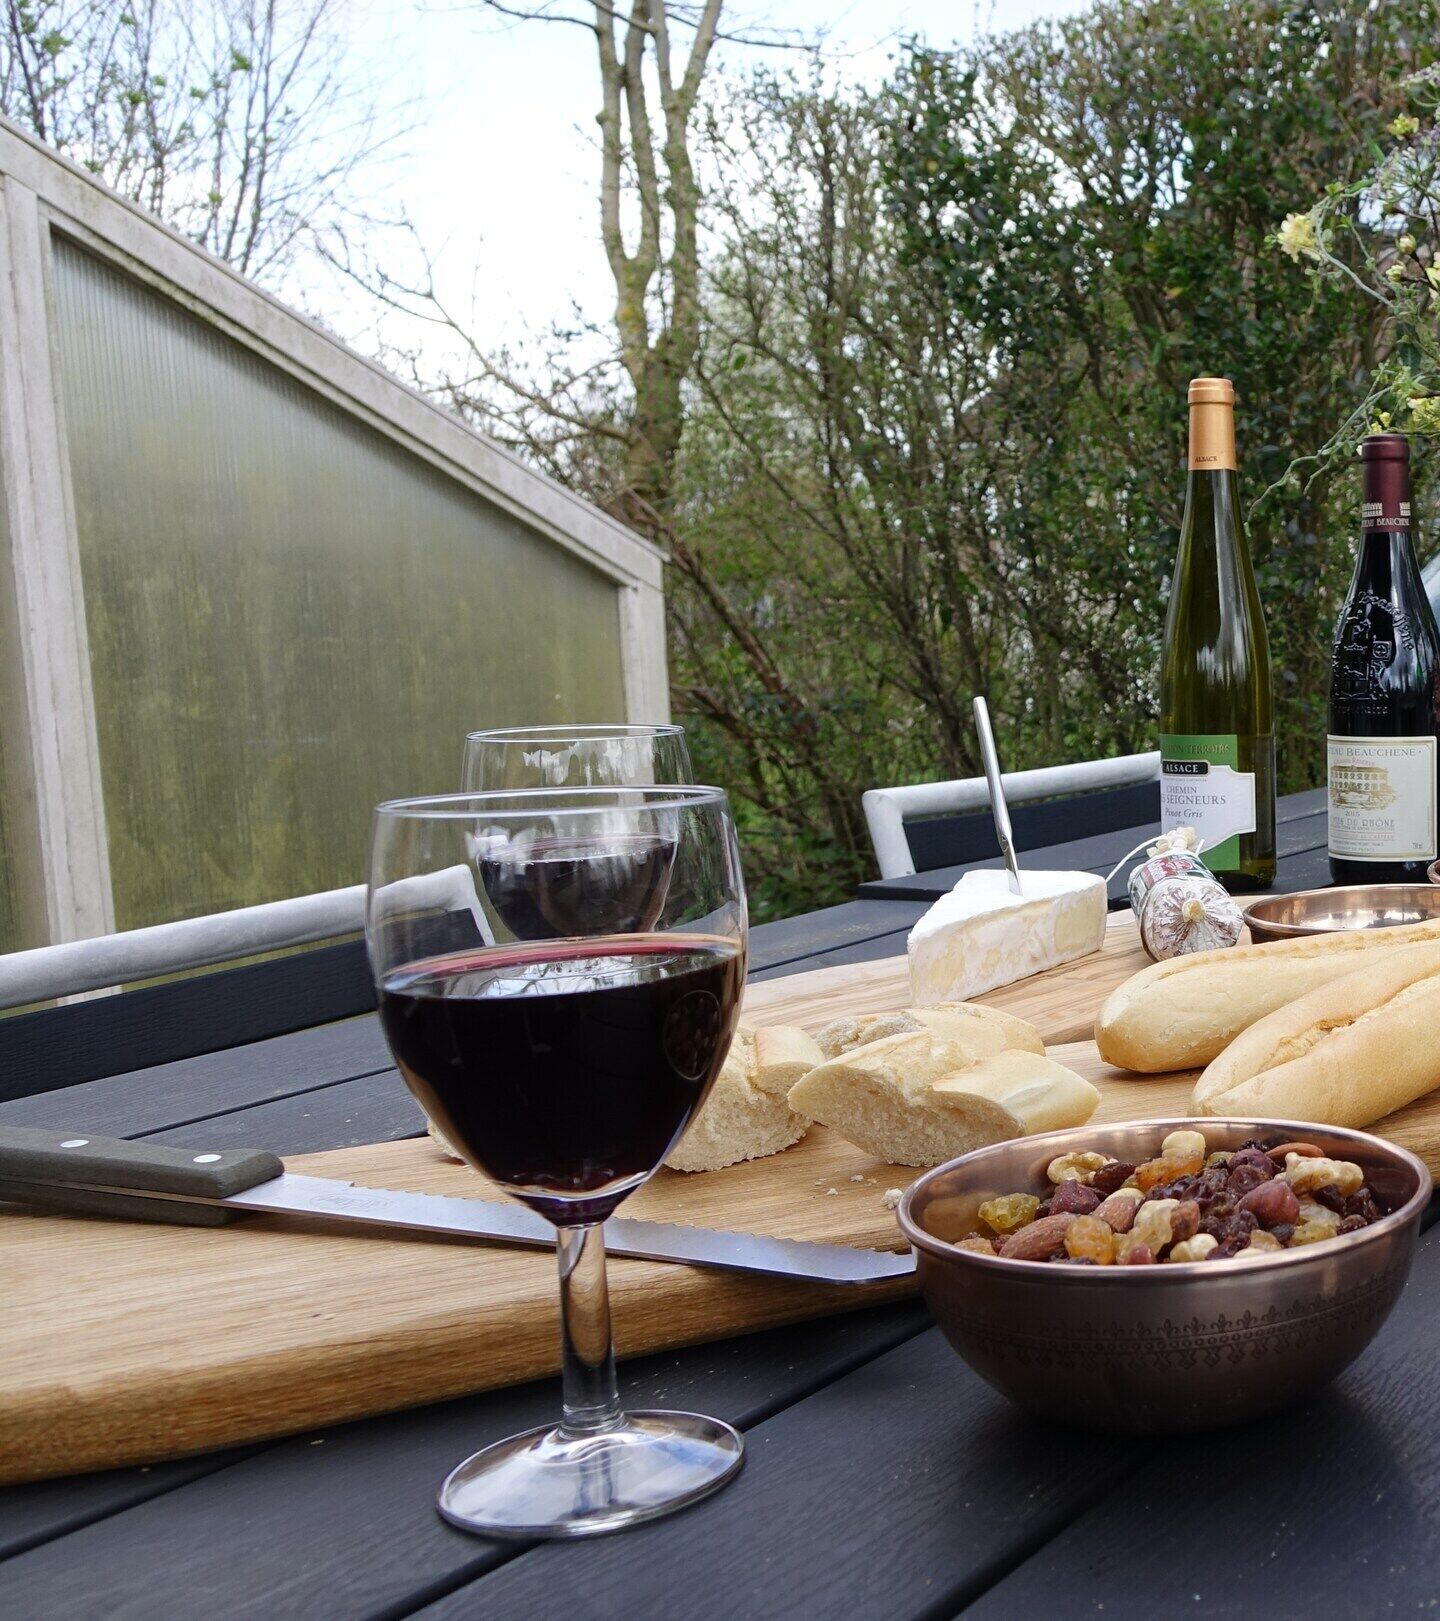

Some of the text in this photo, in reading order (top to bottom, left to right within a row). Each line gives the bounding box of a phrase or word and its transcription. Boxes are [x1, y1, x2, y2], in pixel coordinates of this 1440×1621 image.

[1166, 764, 1198, 773] ALSACE
[1166, 785, 1197, 794] CHEMIN
[1167, 794, 1226, 805] SEIGNEURS
[1183, 808, 1203, 818] Gris
